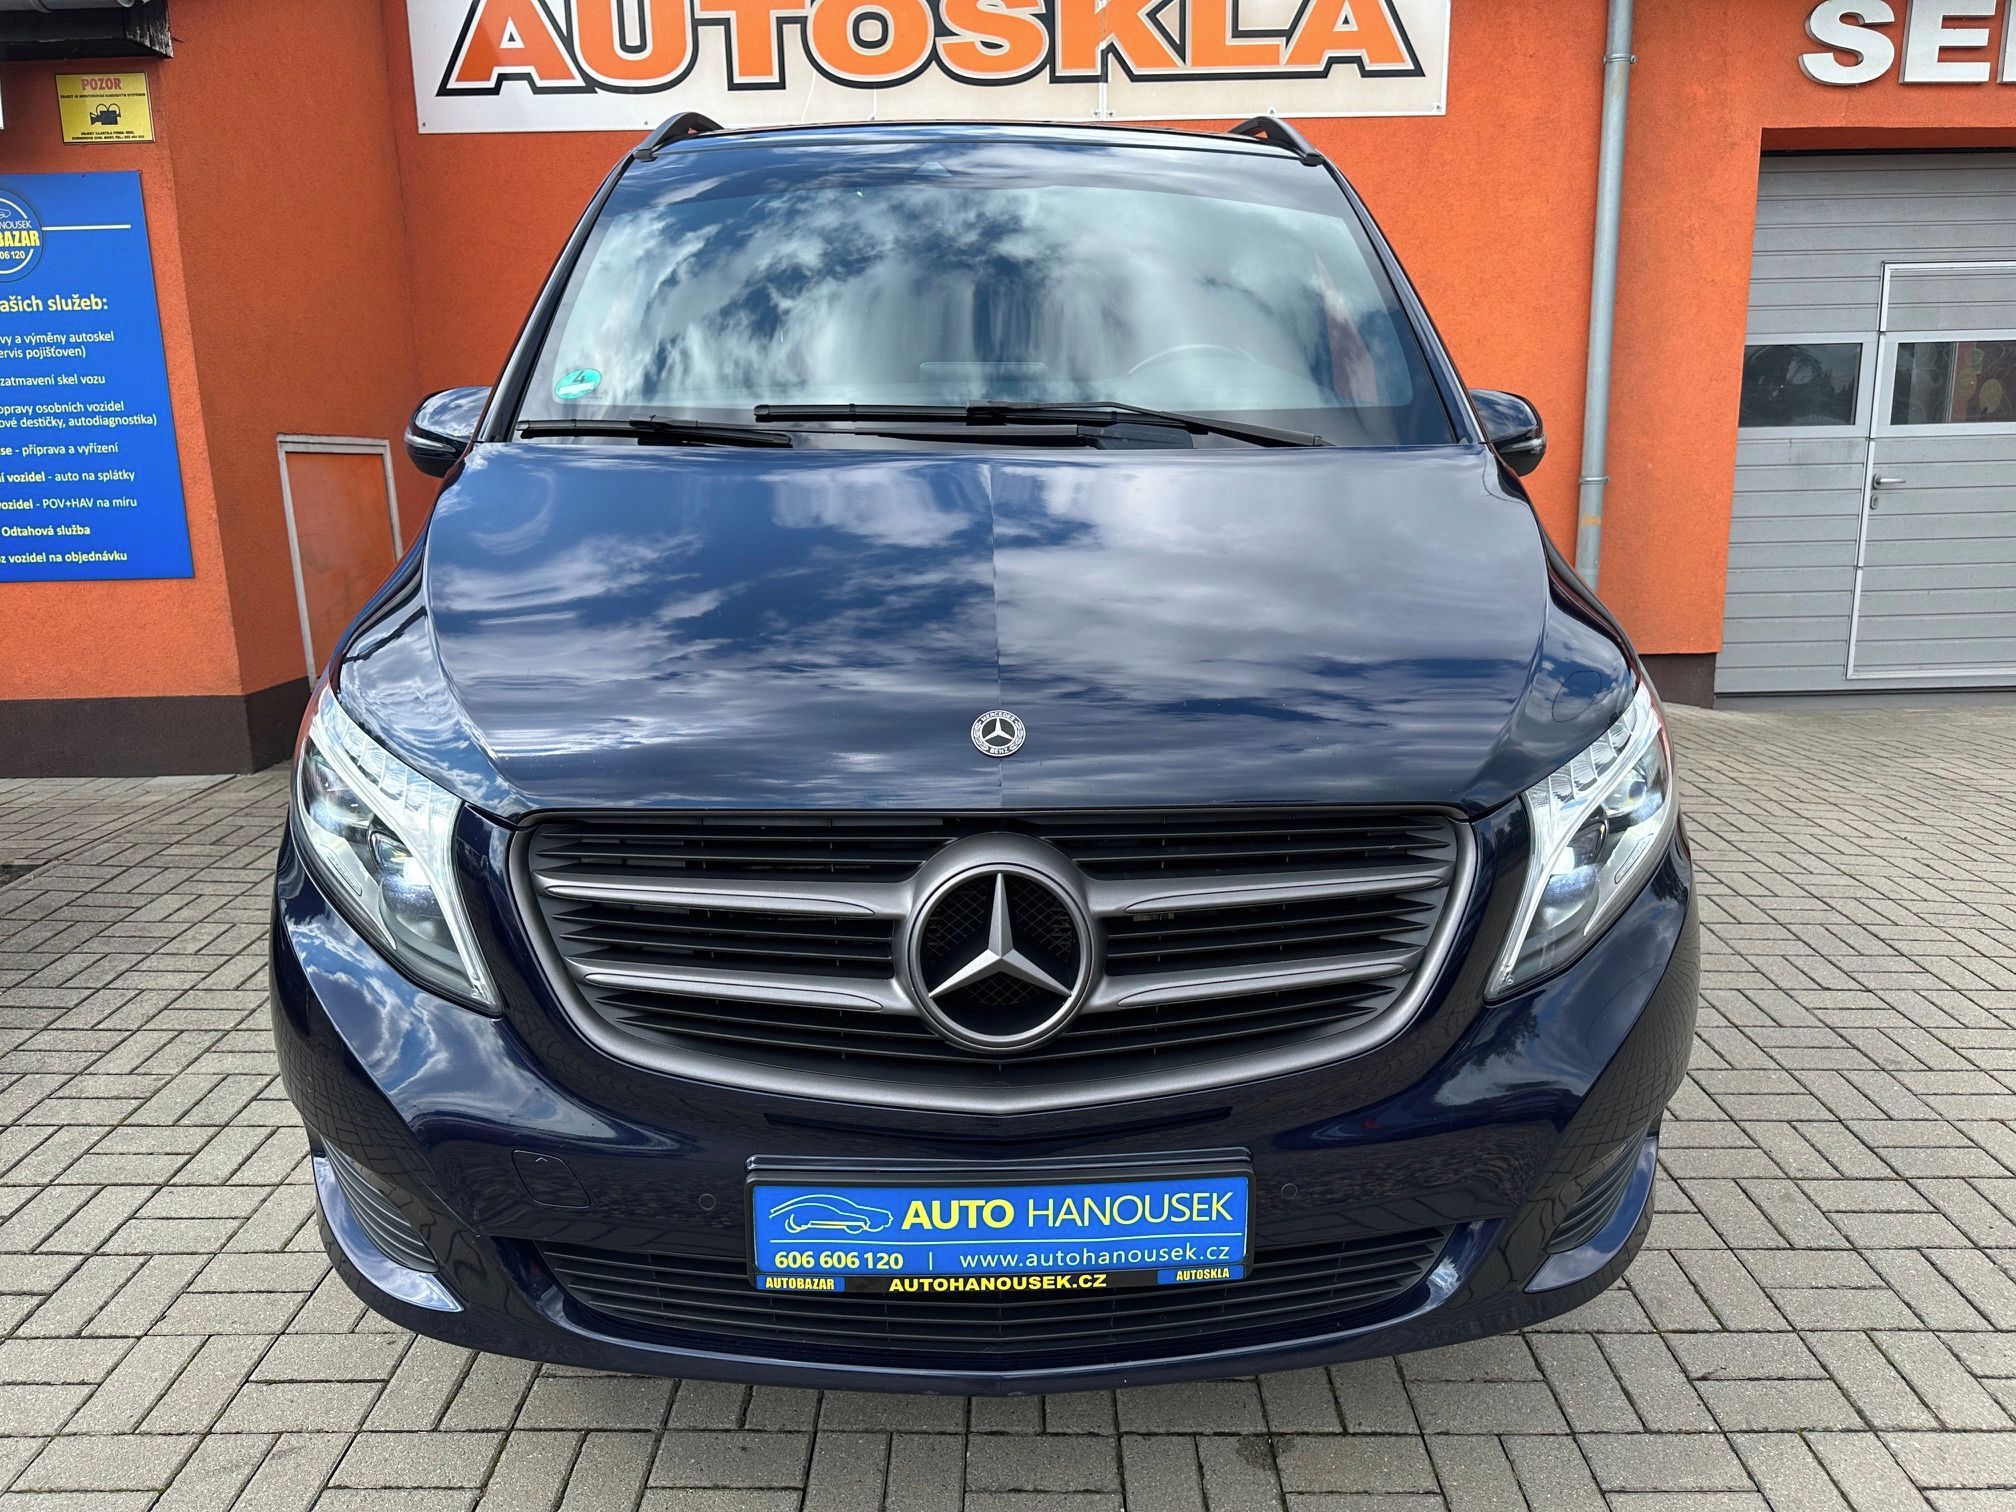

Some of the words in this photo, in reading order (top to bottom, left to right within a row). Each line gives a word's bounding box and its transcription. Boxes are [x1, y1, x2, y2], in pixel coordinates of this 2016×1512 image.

[436, 0, 1425, 97] AUTOSKLA
[1797, 0, 2016, 85] SE
[81, 77, 122, 91] POZOR
[48, 293, 108, 312] služeb:
[15, 335, 22, 344] a
[24, 332, 67, 347] výměny
[70, 331, 115, 343] autoskel
[26, 345, 86, 360] pojišťoven)
[0, 374, 54, 387] zatmavení
[57, 373, 78, 385] skel
[80, 375, 106, 385] vozu
[36, 401, 84, 414] osobních
[86, 400, 125, 412] vozidel
[20, 416, 66, 429] destičky,
[68, 413, 157, 428] autodiagnostika)
[22, 443, 66, 458] příprava
[68, 445, 75, 454] a
[77, 441, 119, 456] vyřízení
[6, 471, 46, 483] vozidel
[55, 472, 79, 482] auto
[82, 473, 96, 481] na
[97, 469, 135, 484] splátky
[0, 498, 34, 510] ozidel
[43, 497, 93, 509] POV+HAV
[97, 499, 110, 508] na
[112, 496, 138, 508] míru
[1, 525, 55, 537] Odtahová
[56, 524, 91, 536] služba
[8, 552, 47, 563] vozidel
[49, 553, 63, 563] na
[64, 550, 128, 565] objednávku
[901, 1199, 1015, 1230] AUTO
[1028, 1192, 1234, 1228] HANOUSEK
[774, 1251, 814, 1269] 606
[819, 1251, 860, 1269] 606
[863, 1252, 904, 1270] 120
[959, 1242, 1230, 1268] www.autohanousek.cz
[1176, 1267, 1230, 1281] AUTOSKLA
[765, 1277, 835, 1290] AUTOBAZAR
[888, 1273, 1107, 1292] AUTOHANOUSEK.CZ
